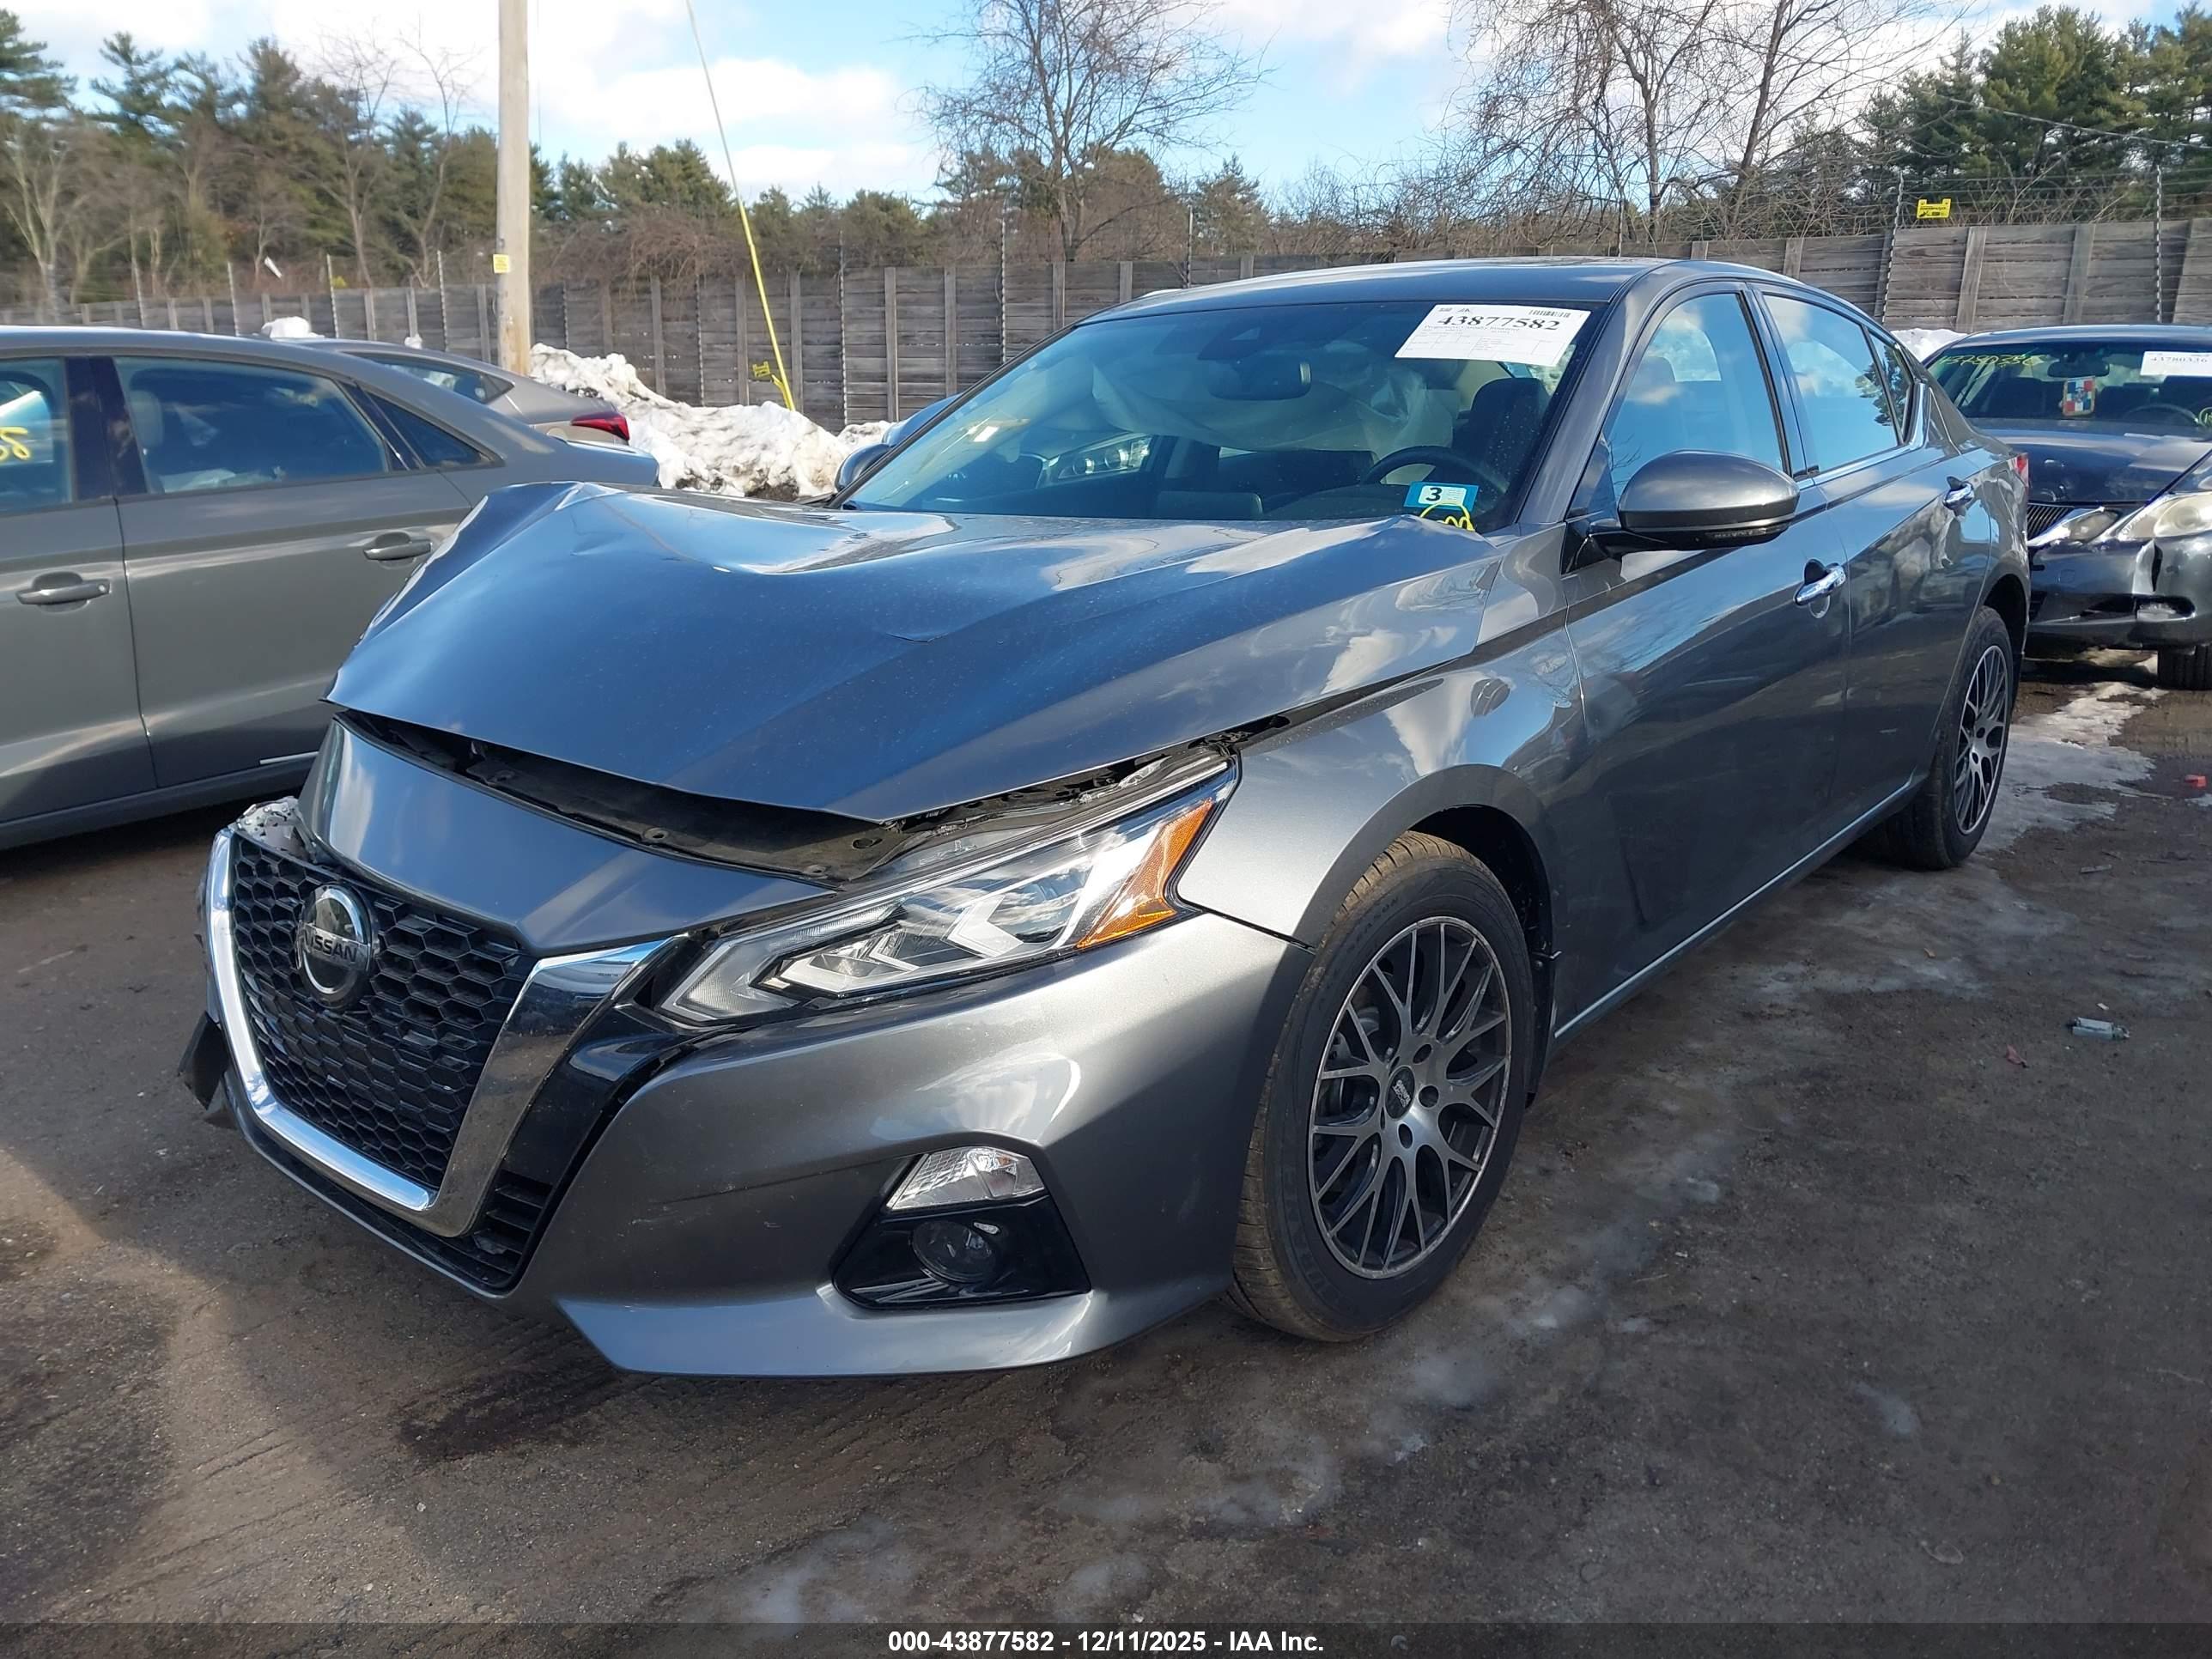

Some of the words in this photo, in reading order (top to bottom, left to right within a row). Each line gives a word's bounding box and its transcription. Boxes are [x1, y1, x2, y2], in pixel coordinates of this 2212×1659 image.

[1437, 315, 1560, 331] 43877582
[1425, 487, 1443, 501] 3
[300, 926, 357, 963] NISSAN
